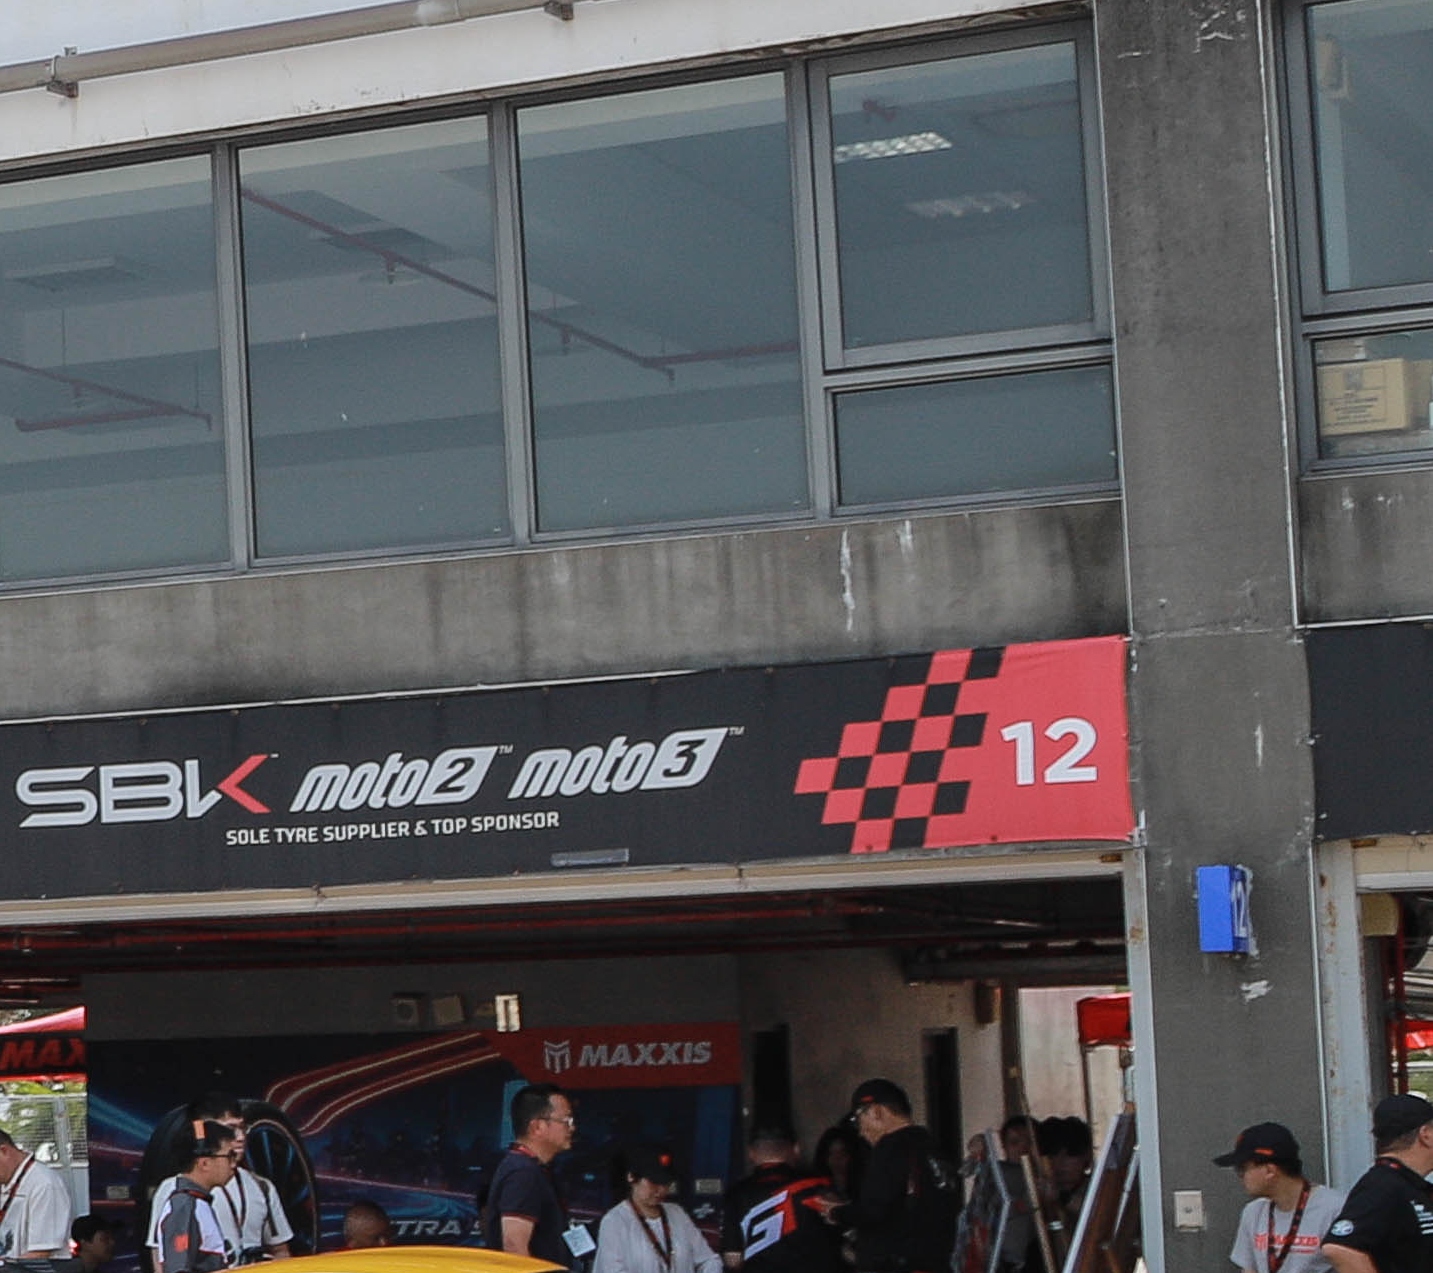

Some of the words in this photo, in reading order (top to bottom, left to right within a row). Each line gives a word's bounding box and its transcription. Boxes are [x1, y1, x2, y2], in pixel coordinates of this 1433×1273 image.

[1000, 717, 1099, 787] 12
[15, 753, 272, 827] SBK
[226, 828, 270, 846] SOLE
[275, 825, 319, 844] TYRE
[323, 821, 410, 842] SUPPLIER
[413, 819, 428, 837] &
[431, 817, 467, 835] TOP
[470, 811, 560, 833] SPONSOR
[578, 1041, 712, 1068] MAXXIS
